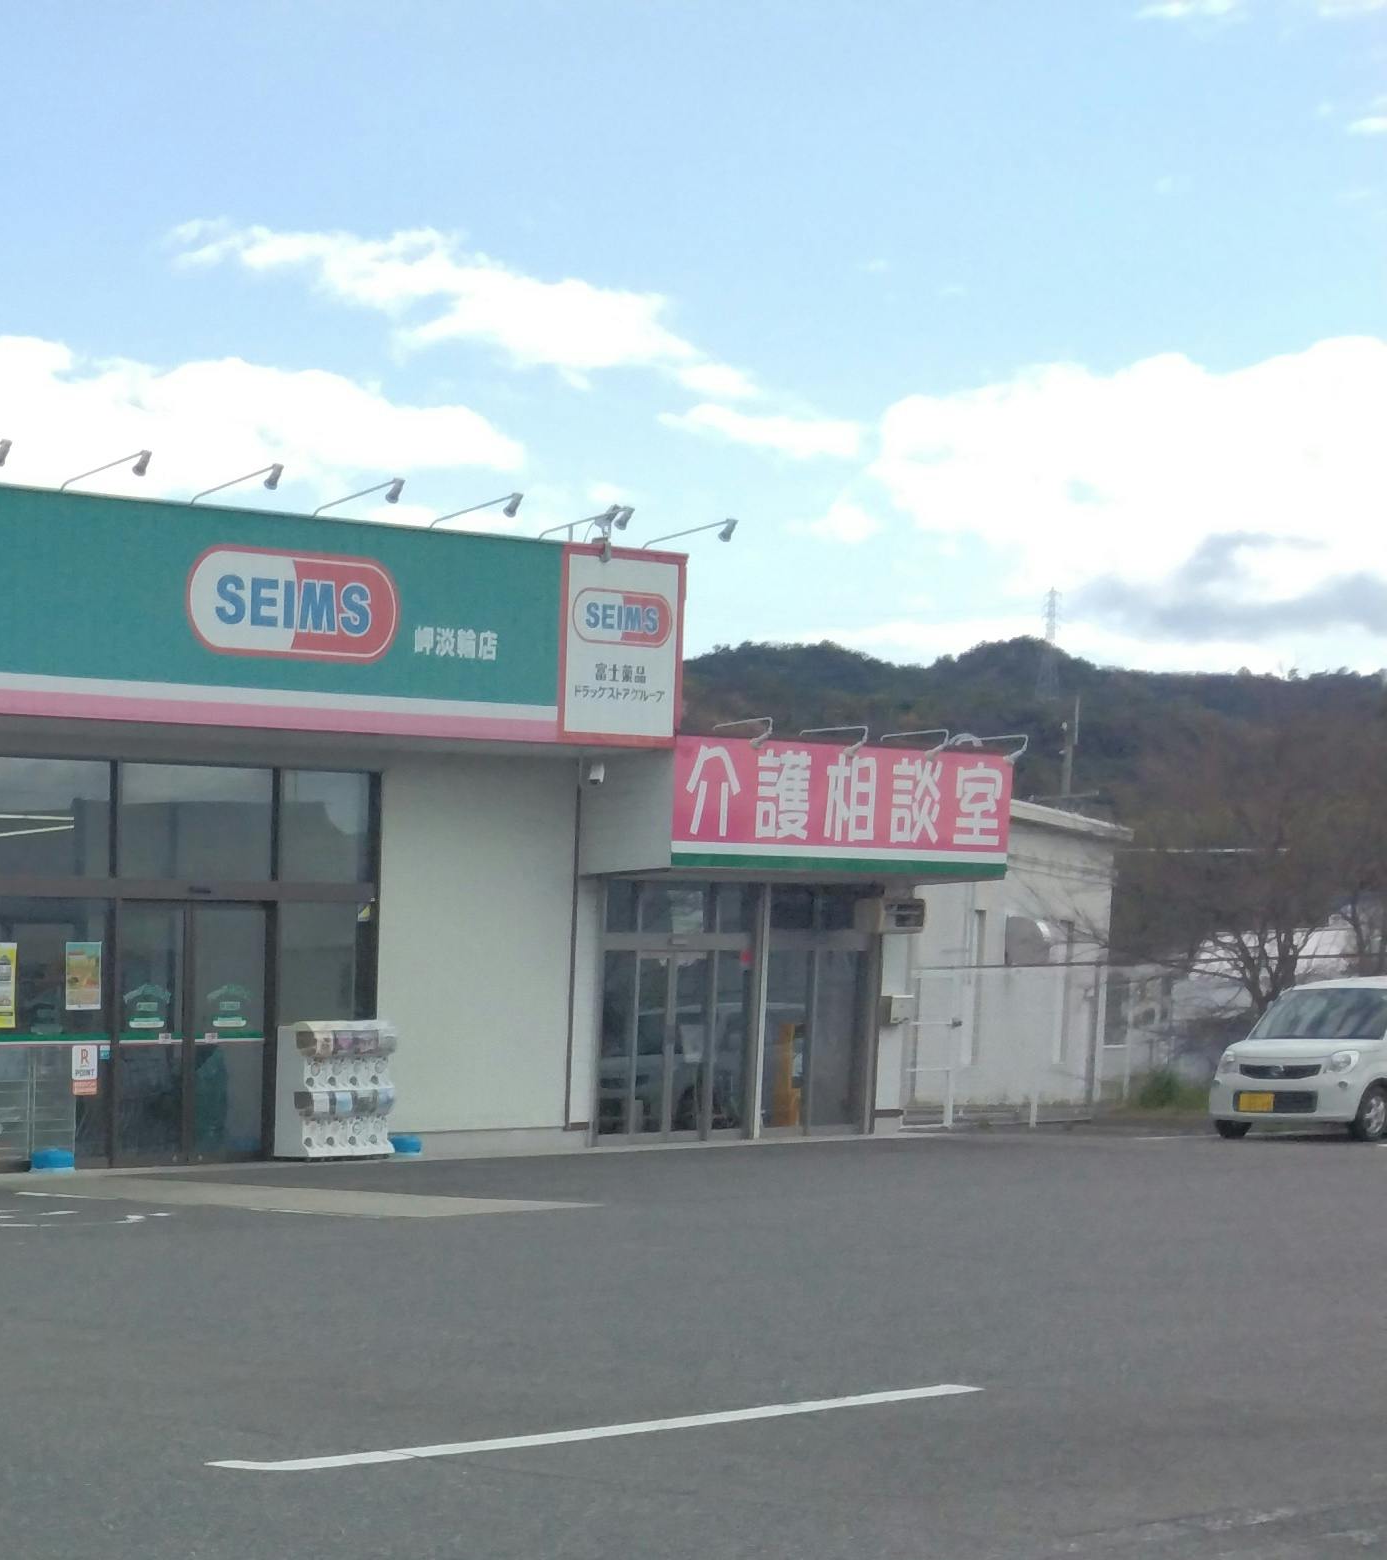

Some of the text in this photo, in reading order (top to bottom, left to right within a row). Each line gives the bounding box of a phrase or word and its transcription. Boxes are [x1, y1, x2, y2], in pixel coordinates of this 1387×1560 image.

[214, 573, 372, 637] SEIMS
[585, 601, 660, 634] SEIMS
[594, 662, 647, 684] 富士薬品
[686, 744, 1004, 848] 介護相談室
